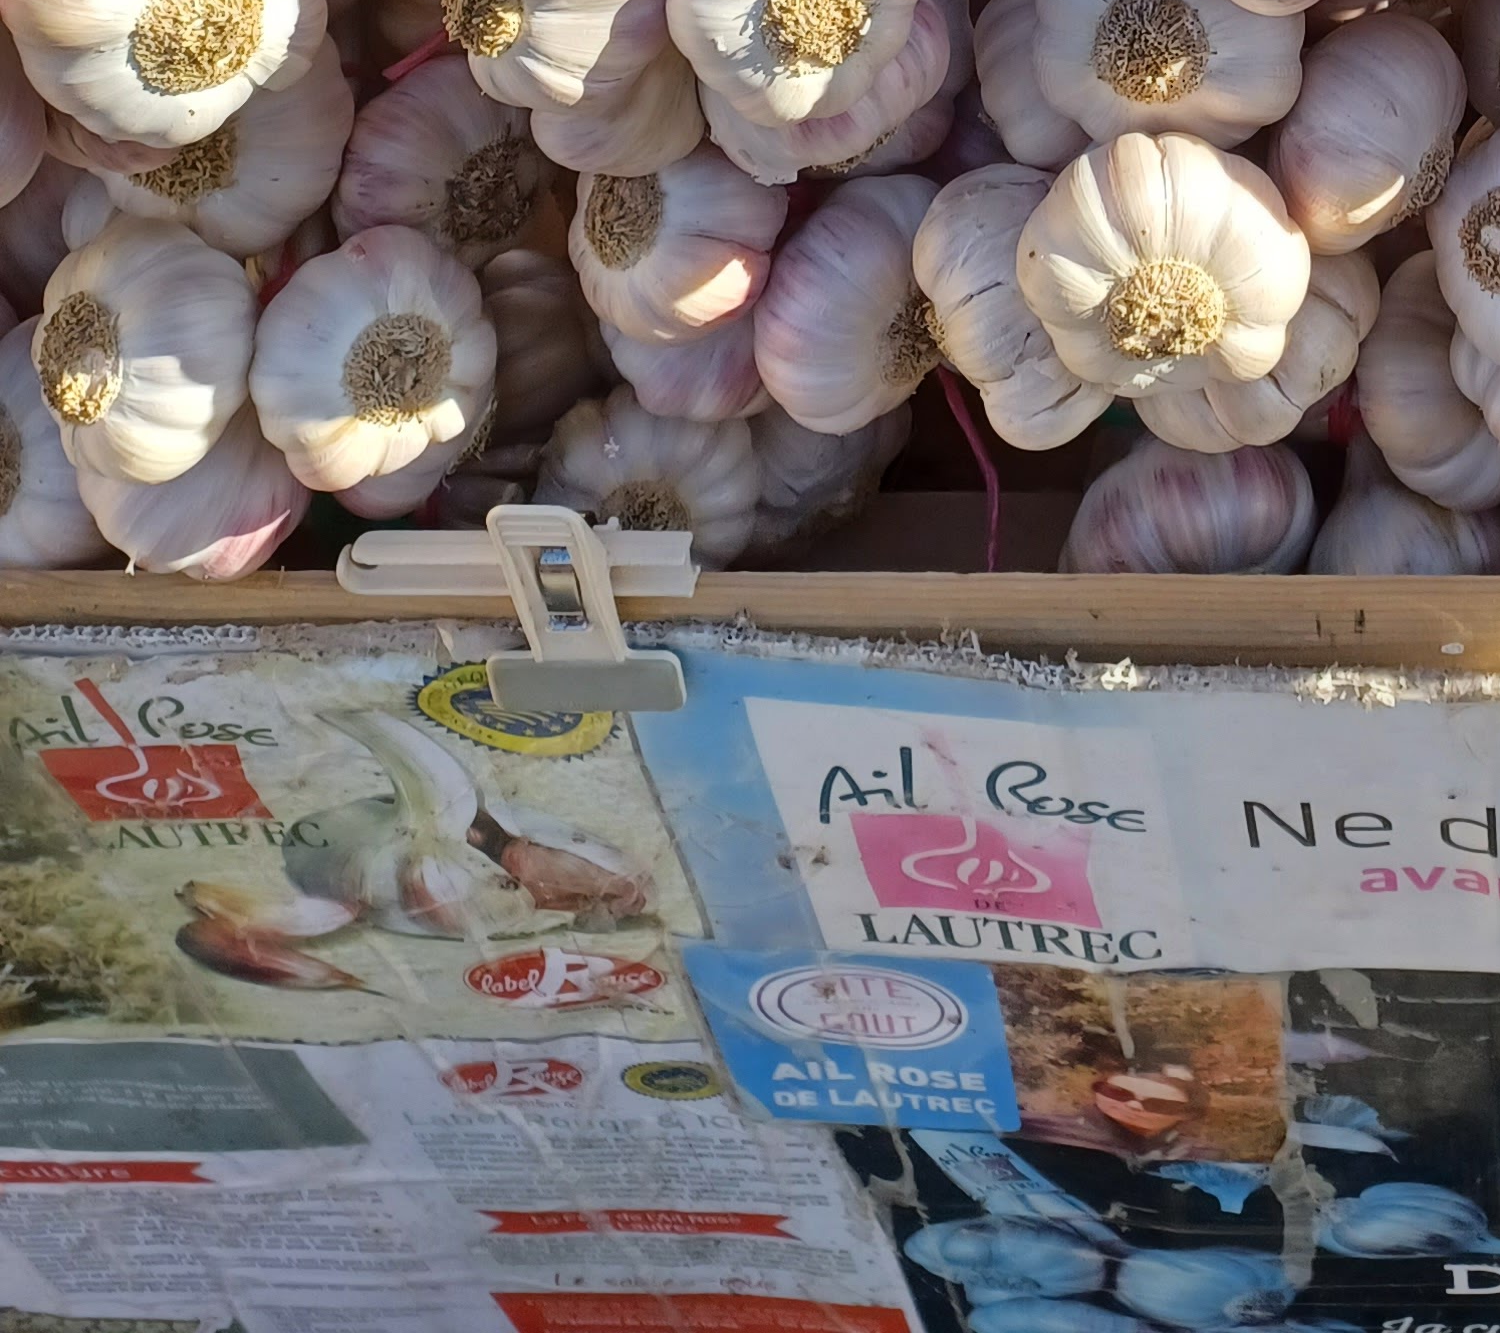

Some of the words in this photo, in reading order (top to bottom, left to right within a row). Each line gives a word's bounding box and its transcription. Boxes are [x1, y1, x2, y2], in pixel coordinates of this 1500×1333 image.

[819, 745, 929, 825] Ail
[107, 820, 329, 849] AUTREC
[1242, 800, 1394, 849] Ne
[852, 911, 1163, 965] LAUTREC
[771, 1060, 856, 1082] AIL
[867, 1061, 988, 1093] ROSE
[772, 1089, 819, 1108] DE
[829, 1089, 997, 1115] LAUTREC
